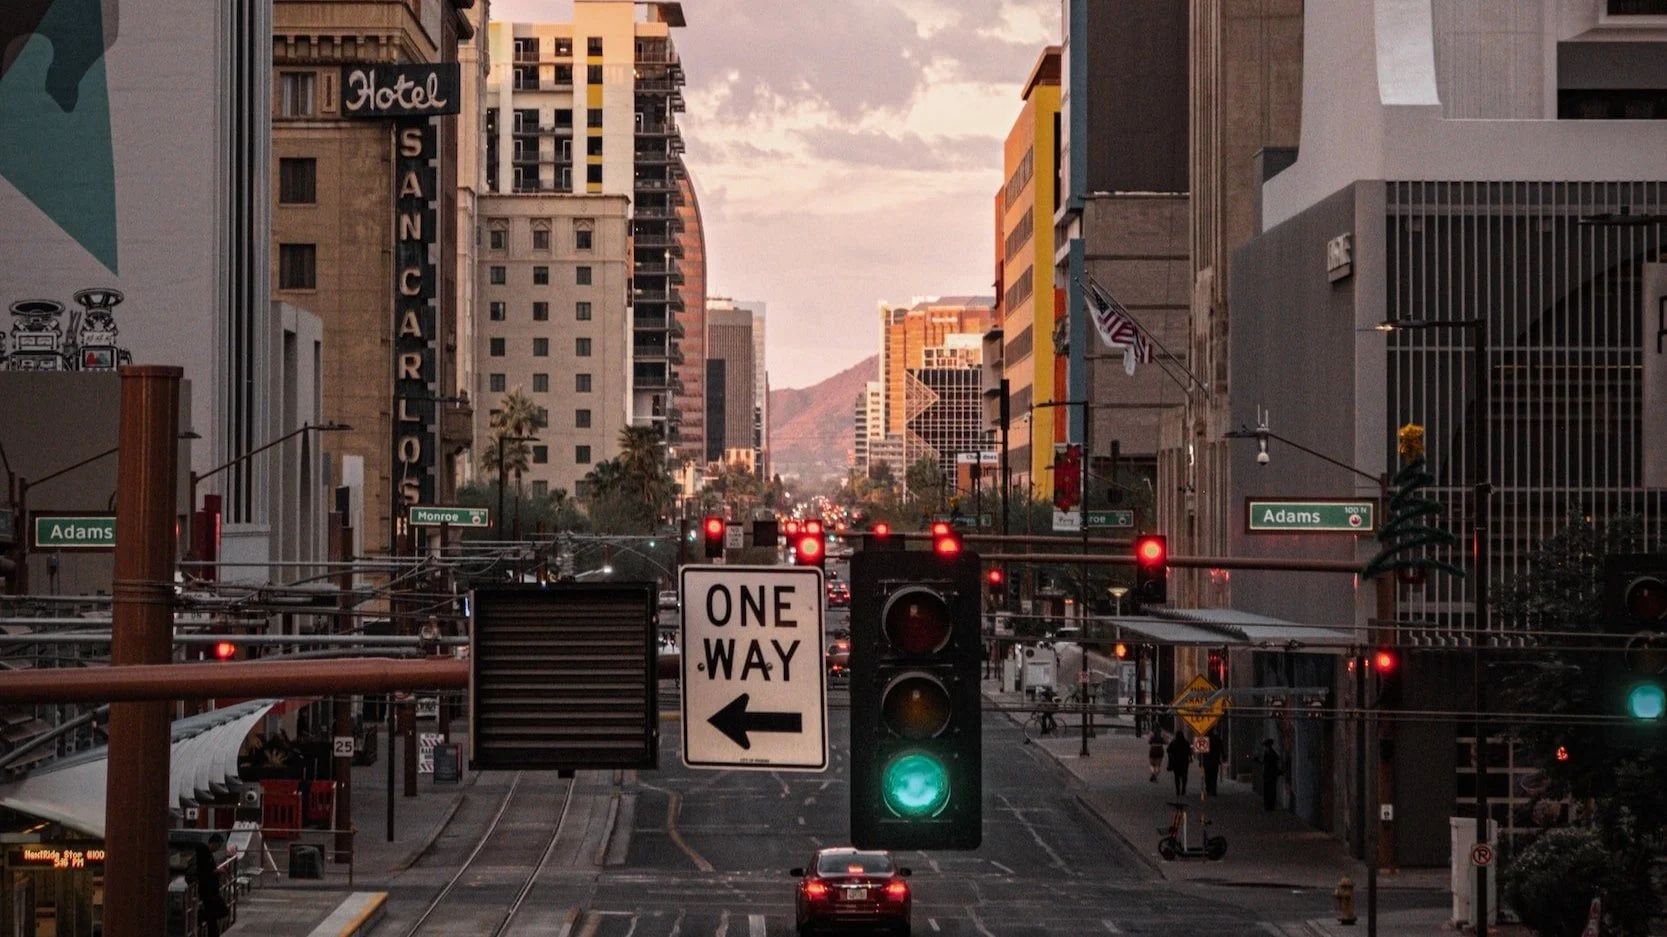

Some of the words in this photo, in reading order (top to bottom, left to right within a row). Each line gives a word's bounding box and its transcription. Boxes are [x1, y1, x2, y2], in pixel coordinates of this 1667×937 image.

[346, 69, 447, 111] Hotel
[400, 128, 423, 240] SAN
[418, 512, 459, 522] Monroe
[1263, 508, 1321, 523] Adams
[50, 524, 113, 540] Adams
[706, 583, 797, 627] ONE
[703, 638, 800, 682] WAY
[335, 741, 353, 753] 25
